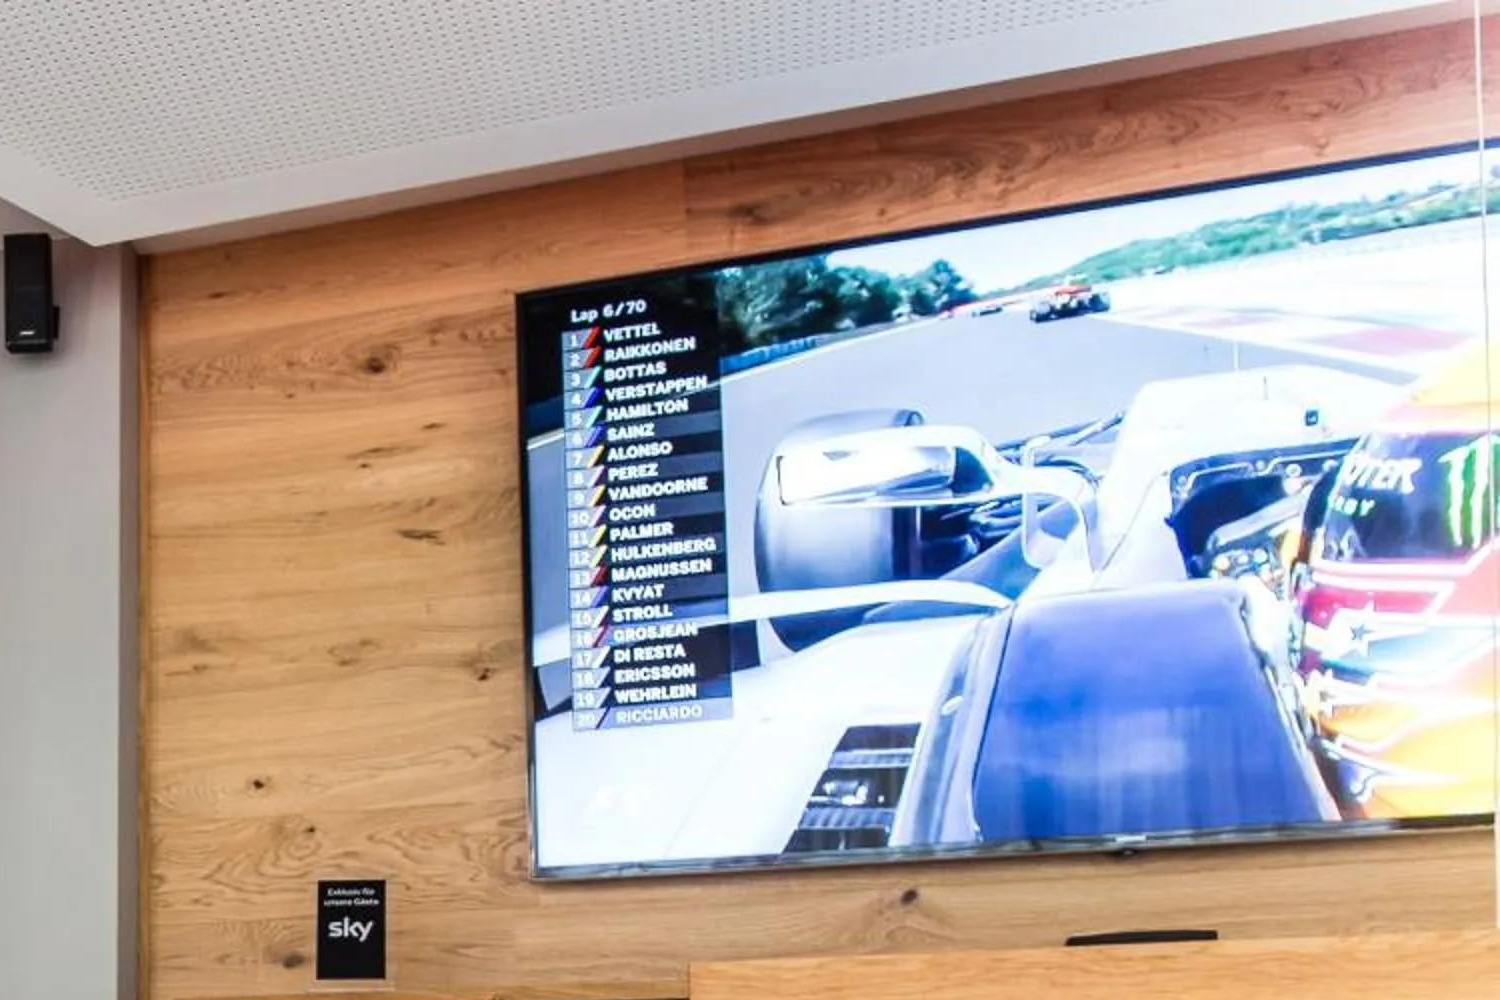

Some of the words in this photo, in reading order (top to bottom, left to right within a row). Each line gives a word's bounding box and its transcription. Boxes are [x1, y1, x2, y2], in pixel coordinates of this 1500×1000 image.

[571, 309, 598, 322] Lap
[603, 300, 647, 317] 6/70
[603, 322, 661, 341] VETTEL
[604, 337, 696, 361] RAIKKONEN
[604, 361, 668, 382] BOTTAS
[605, 376, 707, 400] VERSTAPPEN
[606, 398, 689, 421] HAMILTON
[607, 423, 655, 441] SAINZ
[608, 442, 673, 461] ALONSO
[608, 463, 659, 481] PEREZ
[608, 477, 708, 500] VANDOORNE
[609, 504, 656, 521] OCON
[610, 522, 674, 541] PALMER
[611, 538, 716, 562] HULKENBERG
[612, 558, 712, 582] MAGNUSSEN
[612, 584, 664, 602] KVYAT
[613, 604, 673, 622] STROLL
[613, 622, 698, 642] GROSJEAN
[614, 650, 630, 663] DI
[633, 644, 685, 661] RESTA
[614, 663, 695, 683] ERICSSON
[614, 684, 697, 703] WEHRLEIN
[616, 705, 702, 723] RICCIARDO
[328, 915, 373, 942] sky
